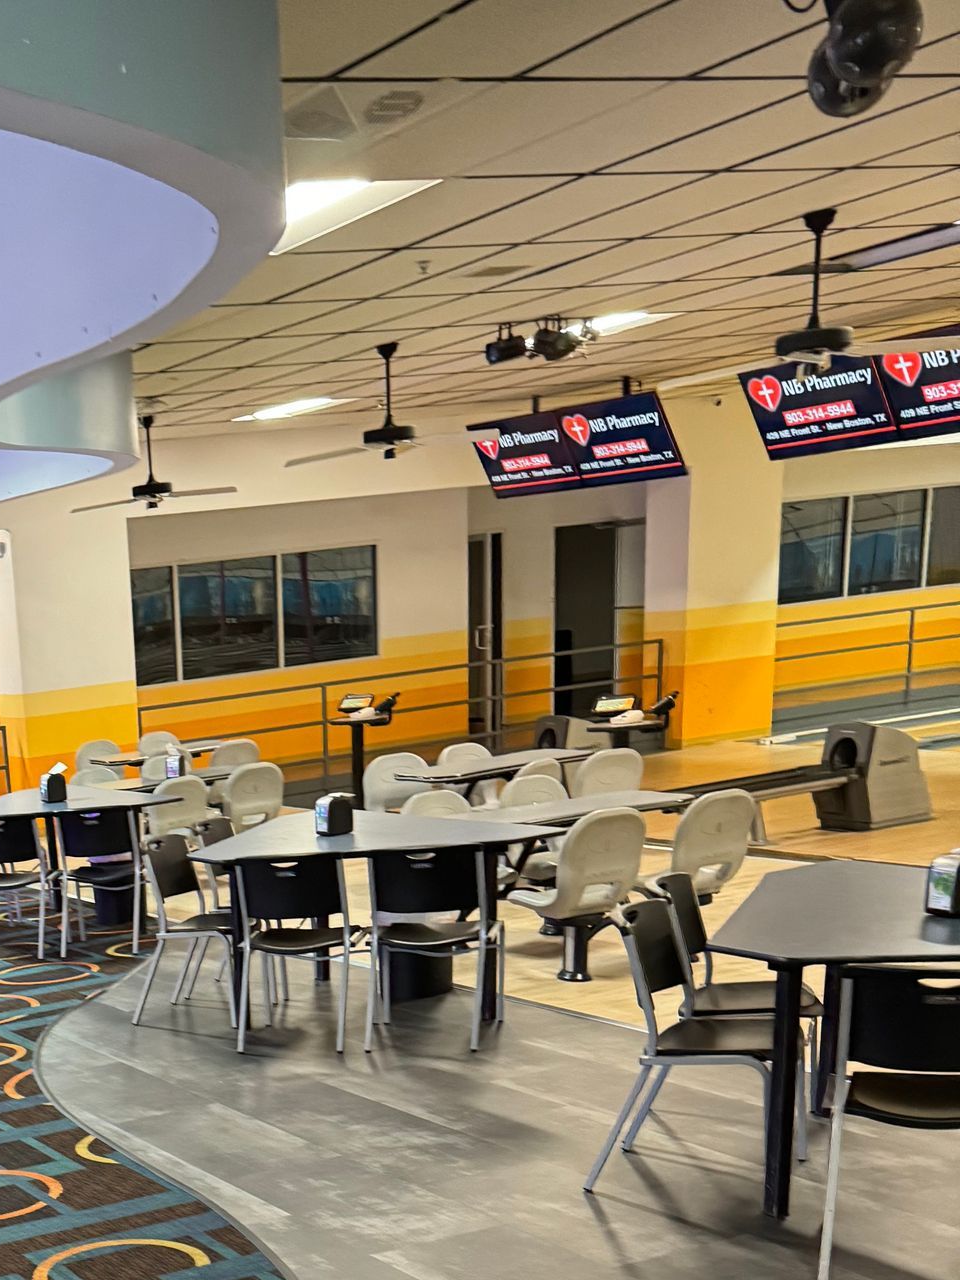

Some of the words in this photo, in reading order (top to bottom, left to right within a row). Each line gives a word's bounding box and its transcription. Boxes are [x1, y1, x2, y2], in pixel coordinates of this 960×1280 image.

[922, 350, 949, 368] NB
[781, 379, 804, 396] NB
[804, 368, 872, 392] Pharmacy
[785, 402, 854, 424] 903-314-5944
[872, 412, 888, 422] TX
[916, 406, 930, 416] NE
[589, 418, 607, 433] NB
[606, 412, 660, 430] Pharmacy
[498, 434, 514, 448] NB
[512, 429, 559, 446] Pharmacy
